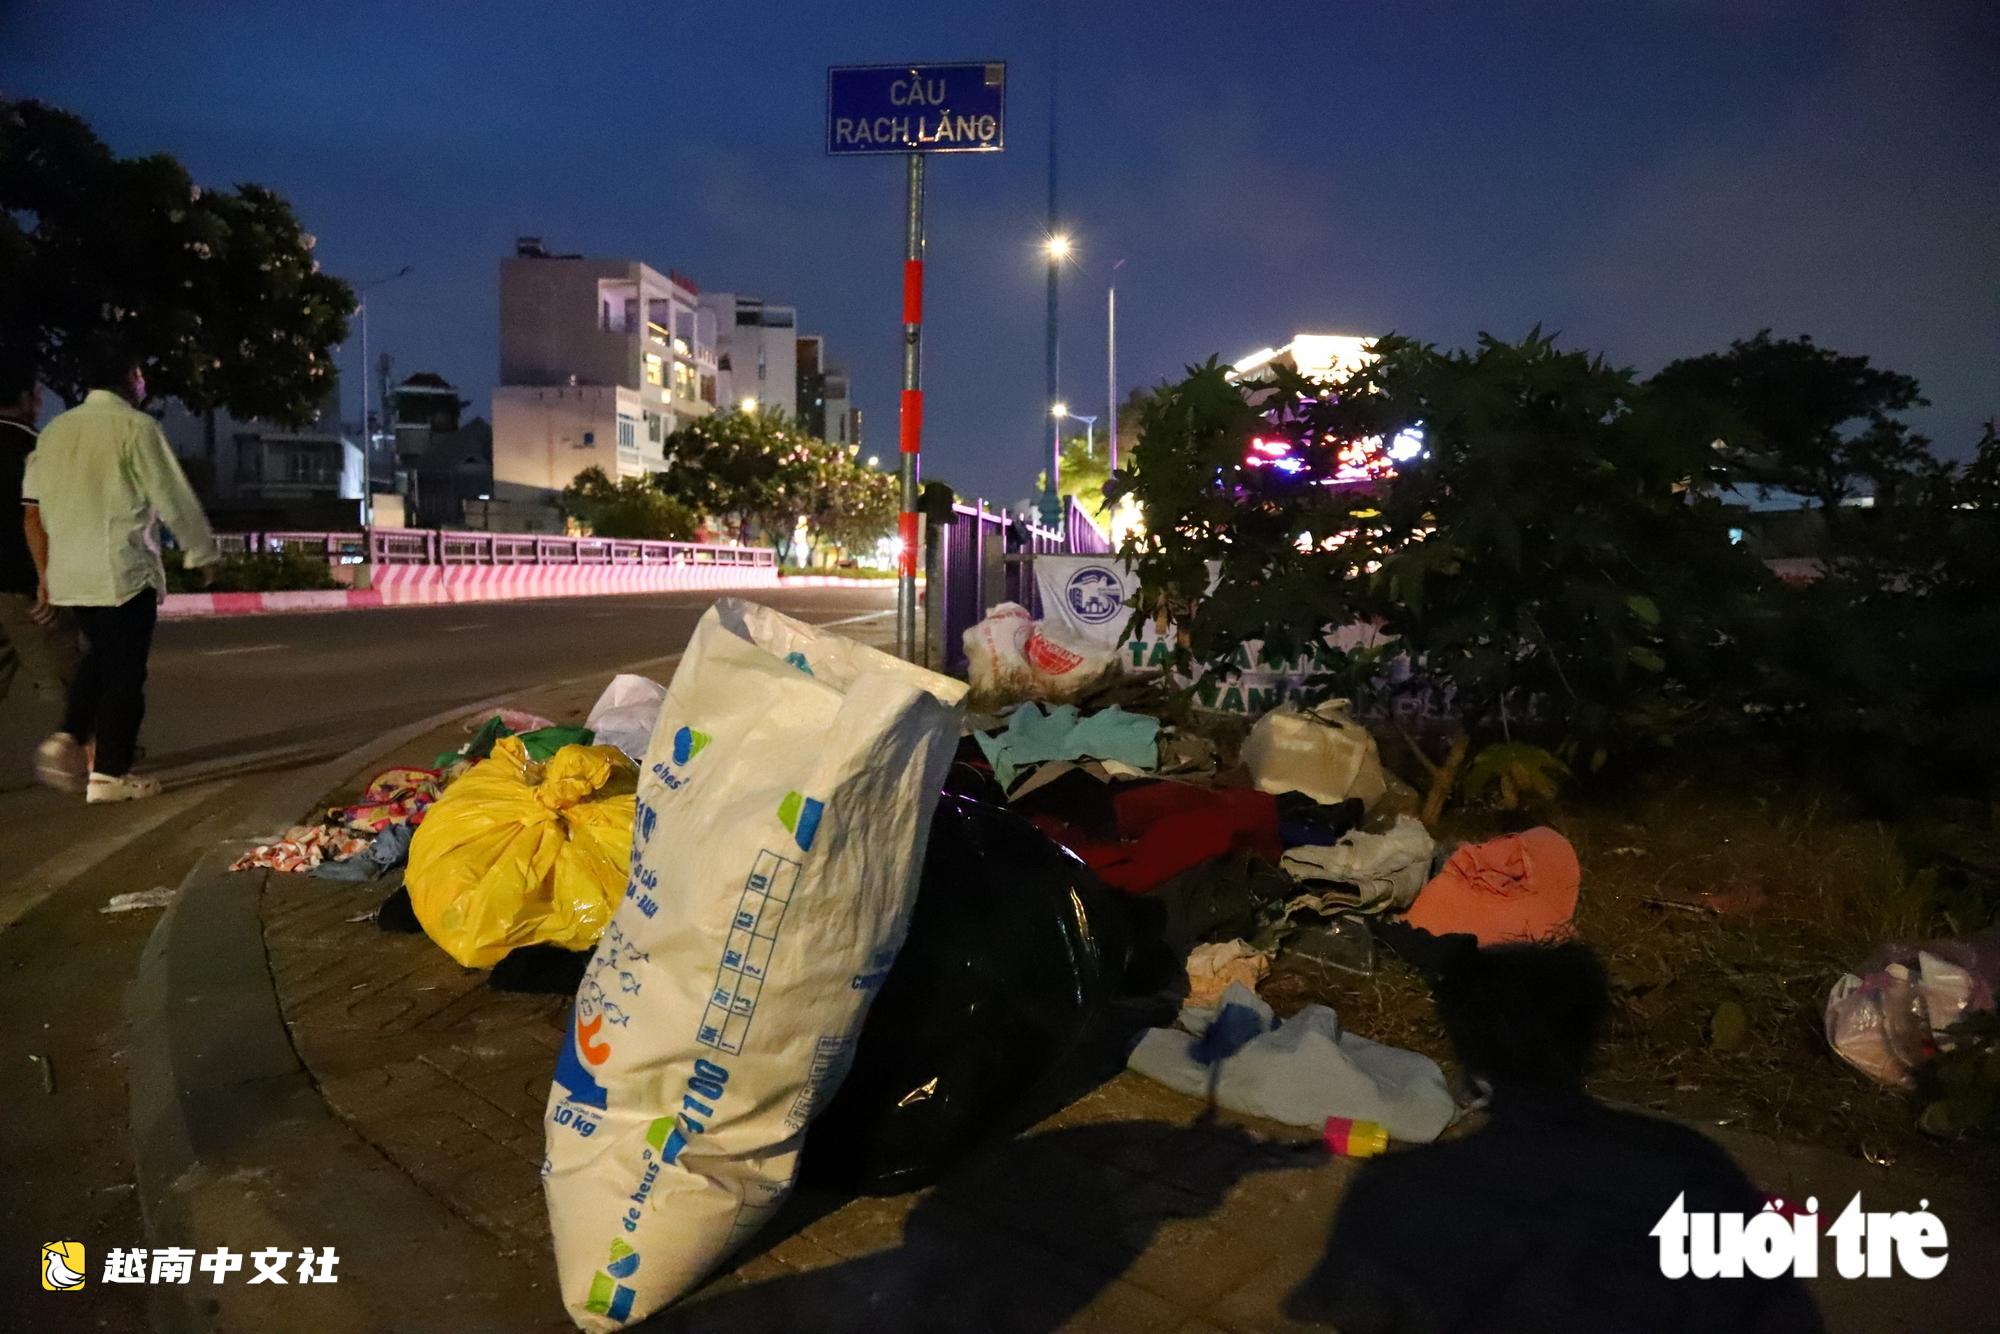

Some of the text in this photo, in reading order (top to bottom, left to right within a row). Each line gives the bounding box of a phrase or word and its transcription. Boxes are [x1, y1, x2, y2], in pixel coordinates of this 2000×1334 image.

[836, 108, 997, 149] RẠCH LĂNG
[571, 1115, 598, 1138] kg
[621, 1160, 661, 1232] de heus
